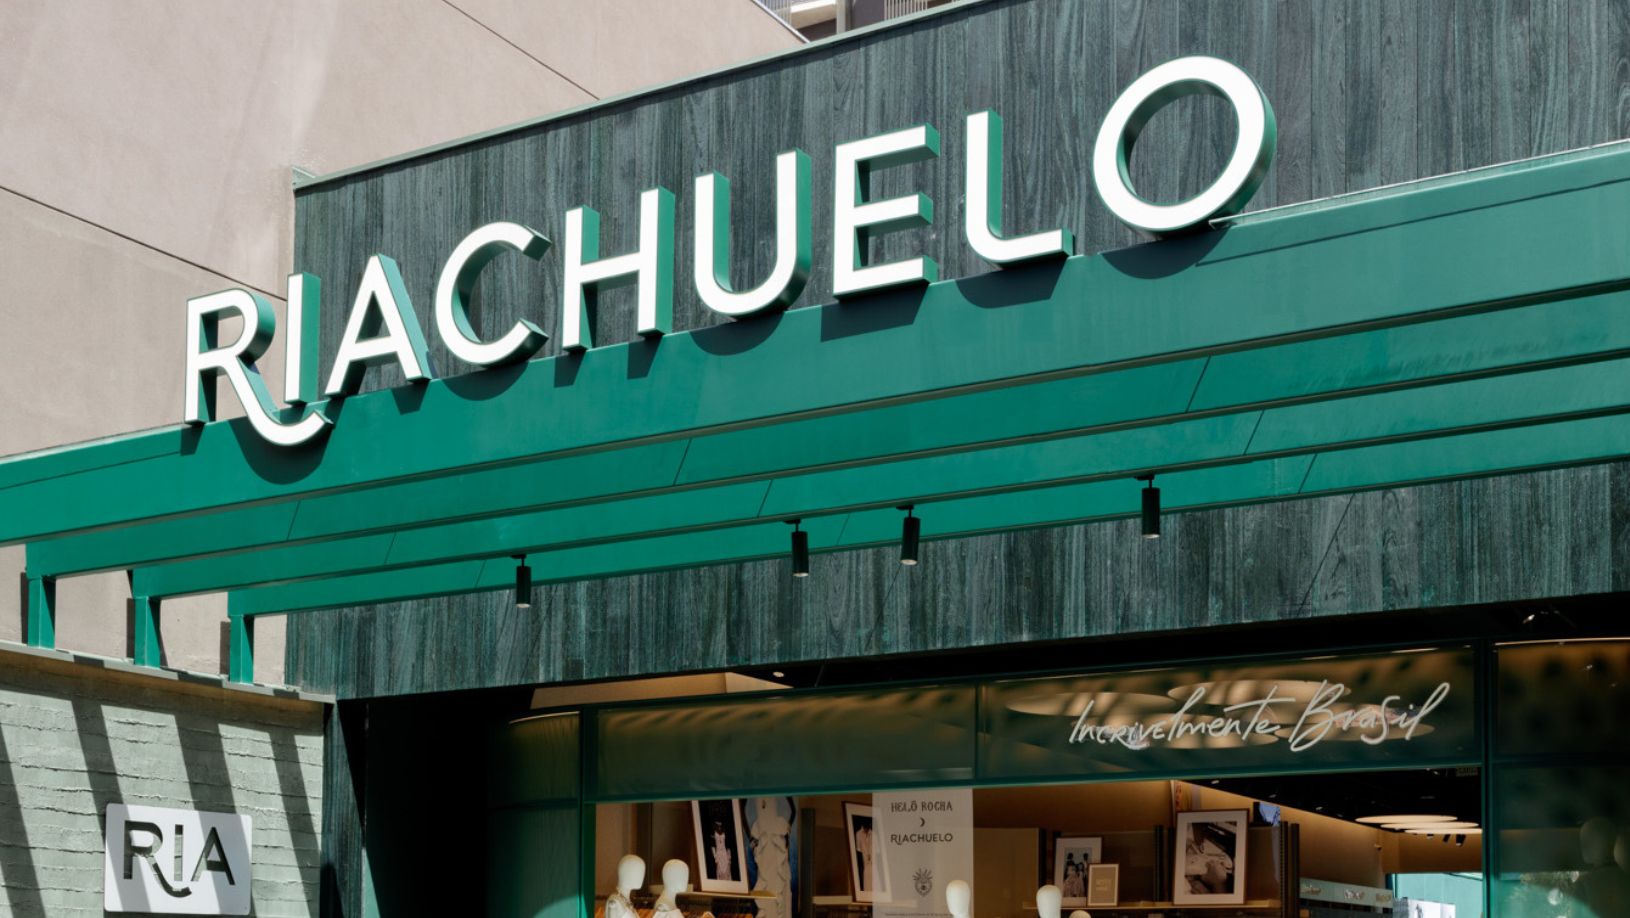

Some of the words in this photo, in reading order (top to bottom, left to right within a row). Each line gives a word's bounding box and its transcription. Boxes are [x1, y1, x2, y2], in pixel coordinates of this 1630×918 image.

[184, 55, 1275, 447] RIACHUELO
[1289, 680, 1450, 752] Brasil
[890, 833, 953, 846] RIACHUELO
[921, 800, 953, 812] ROCHA
[123, 820, 236, 898] RIA
